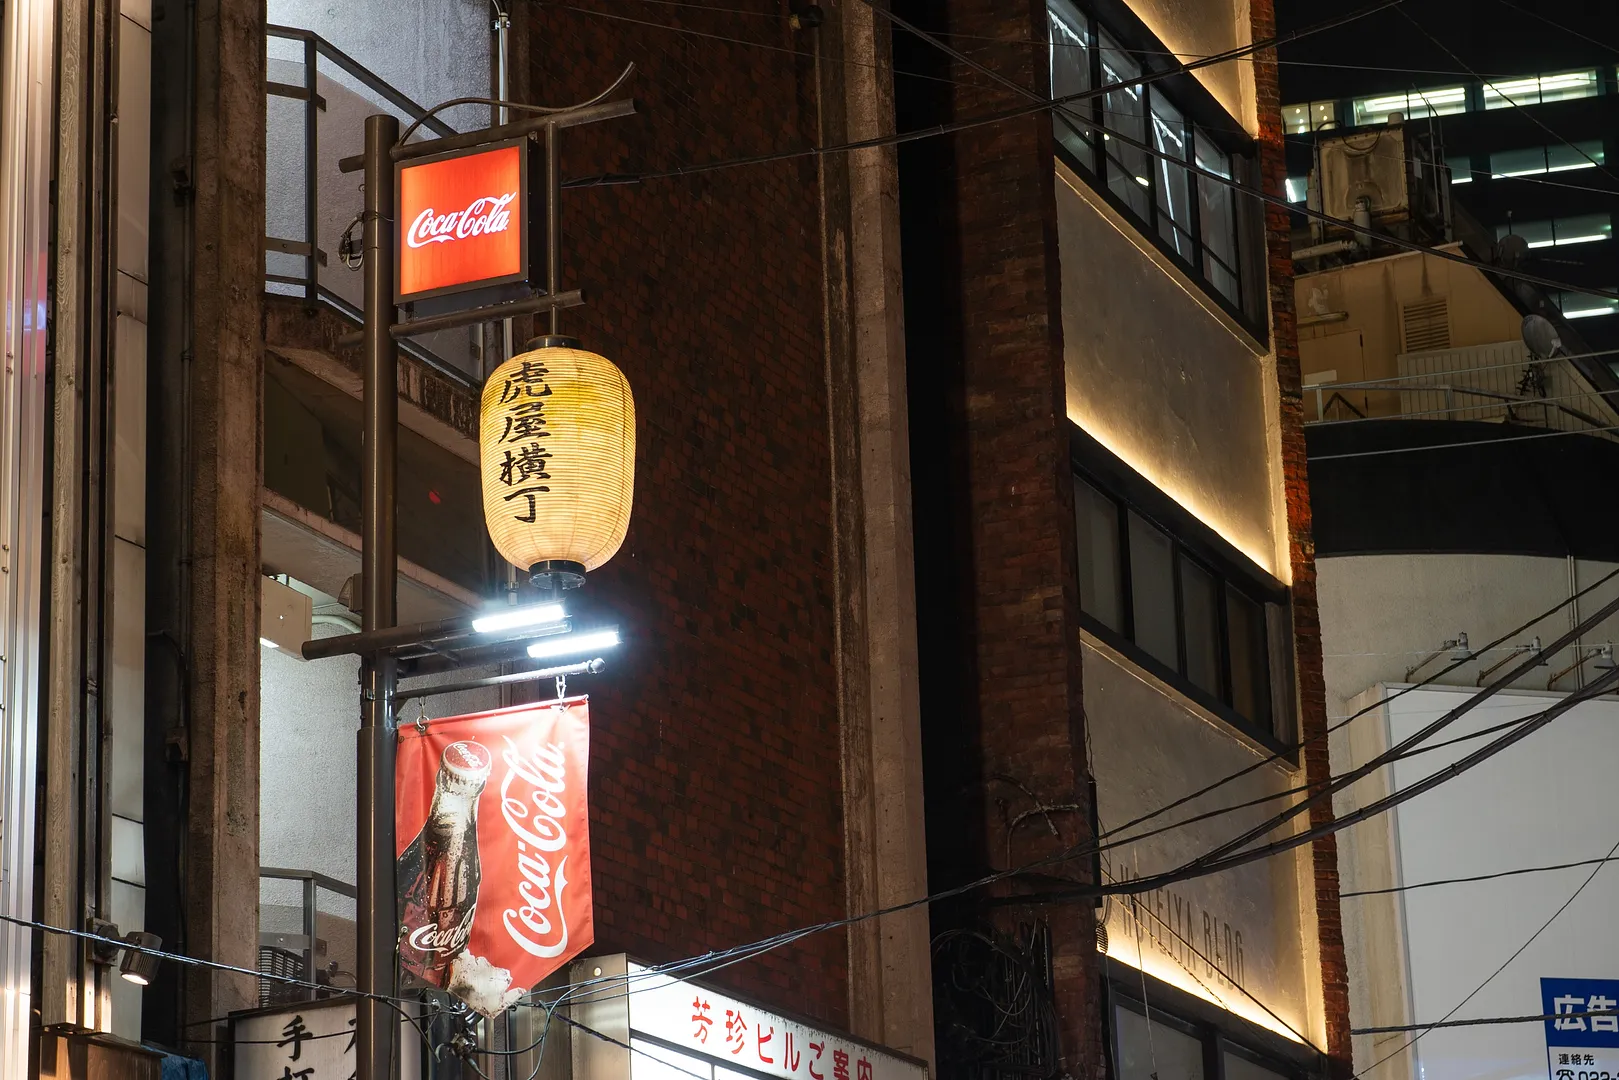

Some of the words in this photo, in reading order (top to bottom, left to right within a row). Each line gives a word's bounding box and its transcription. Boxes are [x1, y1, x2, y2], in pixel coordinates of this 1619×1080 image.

[407, 191, 517, 248] Coca-Cola
[498, 361, 553, 523] 虎屋横丁
[501, 735, 569, 959] Coca-Cola
[1203, 910, 1246, 997] BLDG
[691, 996, 874, 1080] 芳珍ビルご案内
[1553, 994, 1619, 1033] 広告
[1558, 1053, 1595, 1066] 連絡先
